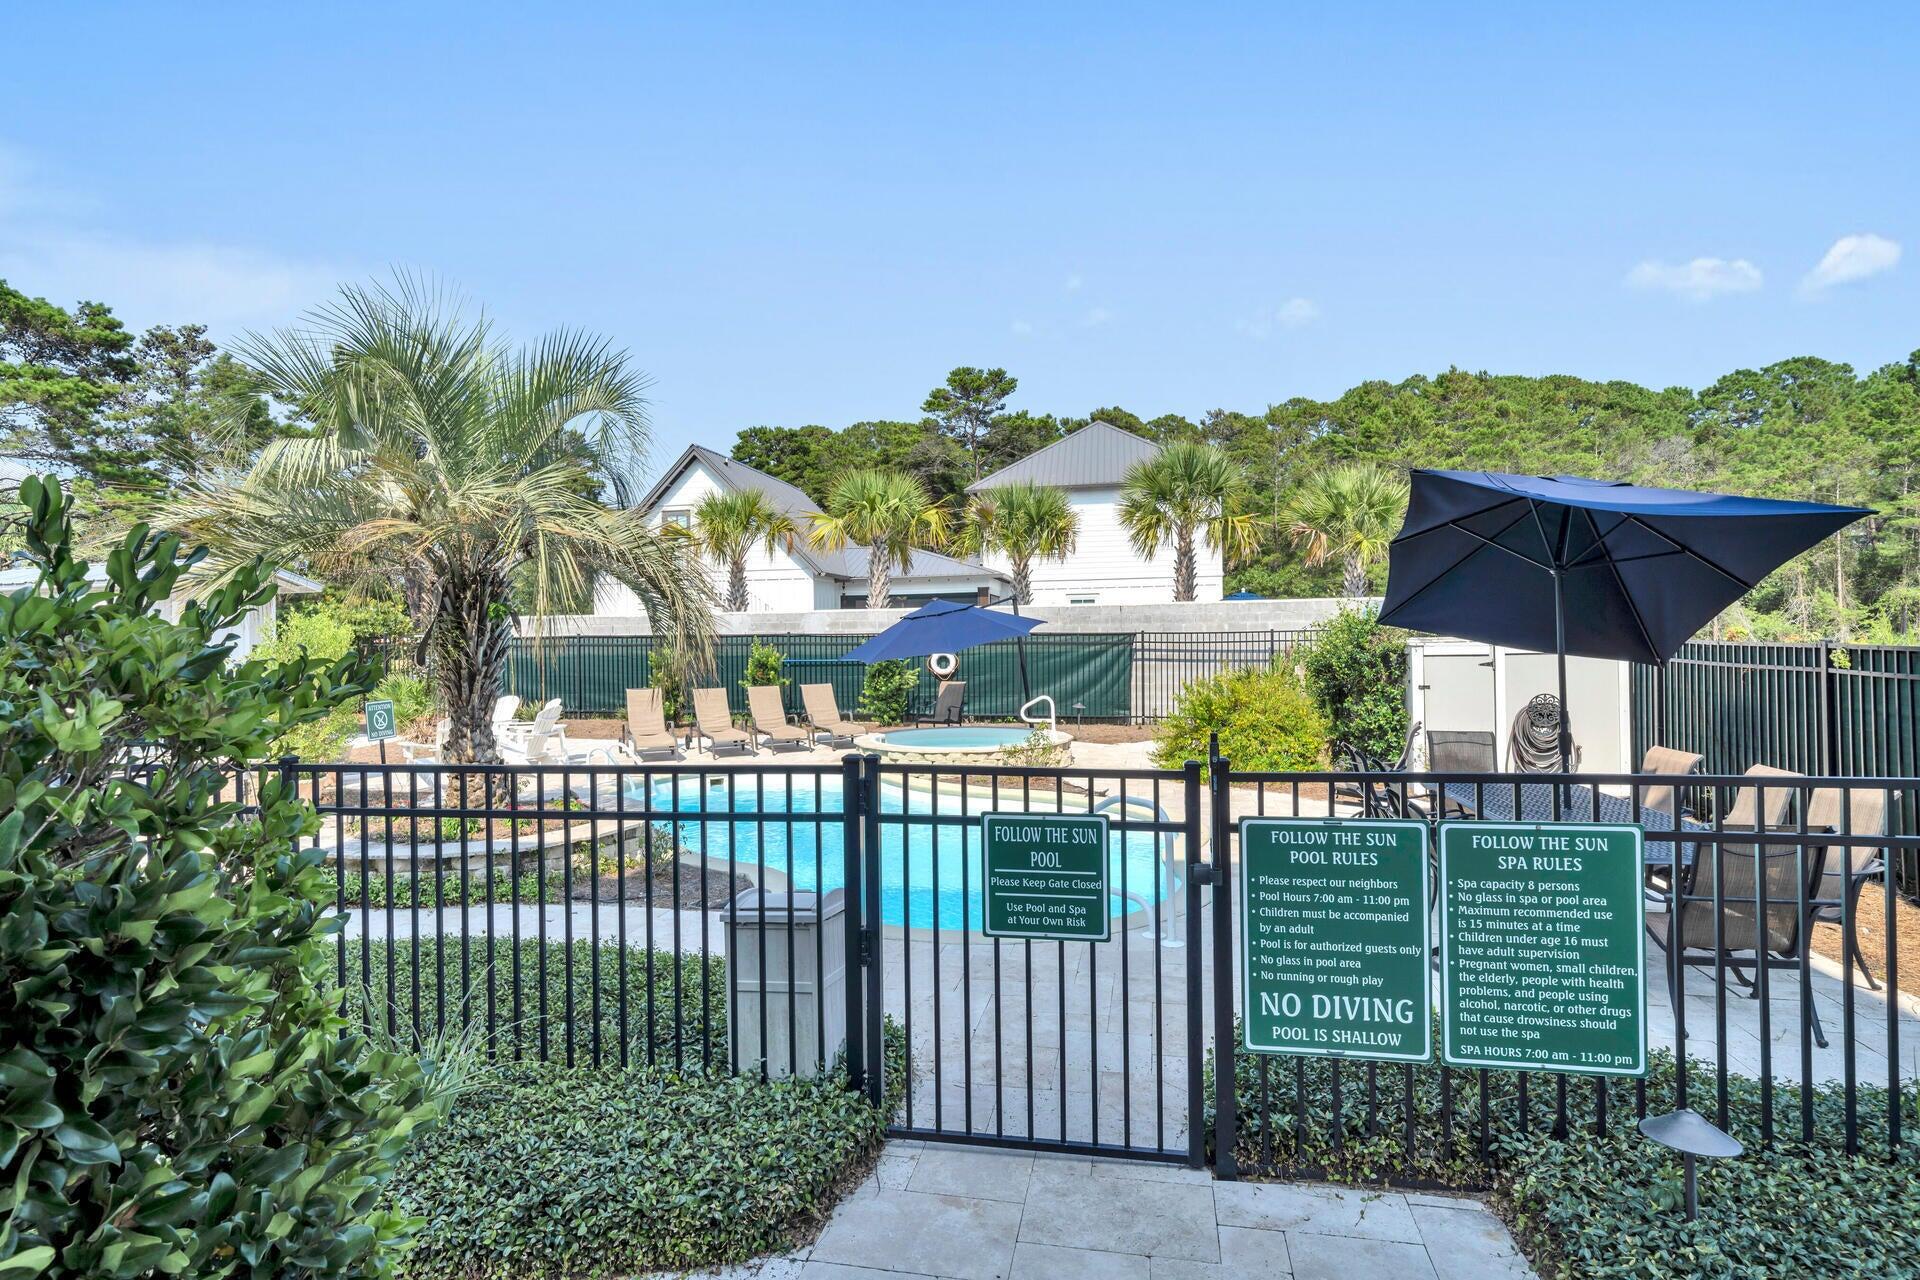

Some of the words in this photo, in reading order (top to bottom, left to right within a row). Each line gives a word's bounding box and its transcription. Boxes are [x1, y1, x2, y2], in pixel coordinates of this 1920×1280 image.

[995, 826, 1041, 843] FOLLOW
[1045, 828, 1068, 843] THE
[1072, 828, 1097, 844] SUN
[1271, 831, 1328, 845] FOLLOW
[1332, 832, 1361, 845] THE
[1366, 833, 1397, 847] SUN
[1472, 835, 1534, 849] FOLLOW
[1539, 837, 1570, 850] THE
[1575, 837, 1609, 851] SUN
[1031, 852, 1061, 868] POOL
[1290, 851, 1328, 864] POOL
[1333, 852, 1378, 865] RULES
[1498, 856, 1527, 870] SPA
[1533, 857, 1582, 871] RULES
[991, 877, 1019, 886] Please
[1023, 879, 1045, 889] Keep
[1049, 879, 1069, 888] Gate
[1072, 880, 1101, 889] Closed
[1259, 876, 1290, 886] Please
[1292, 878, 1327, 888] respect
[1349, 879, 1398, 889] neighbors
[1457, 879, 1477, 890] Spa
[1480, 880, 1525, 891] capacity
[1528, 881, 1535, 890] 8
[1538, 882, 1580, 892] persons
[1259, 892, 1280, 901] Pool
[1283, 893, 1311, 902] Hours
[1314, 894, 1335, 903] 7:00
[1337, 896, 1353, 904] am
[1363, 896, 1391, 905] 11:00
[1394, 898, 1410, 907] pm
[1458, 892, 1472, 901] No
[1476, 893, 1503, 904] glass
[1506, 893, 1516, 903] in
[1519, 895, 1538, 904] spa
[1541, 896, 1553, 904] or
[1556, 895, 1578, 906] pool
[1582, 897, 1607, 906] area
[1007, 903, 1023, 911] Use
[1026, 904, 1045, 912] Pool
[1048, 905, 1066, 913] and
[1069, 905, 1086, 915] Spa
[1259, 908, 1299, 918] Children
[1302, 910, 1326, 919] must
[1329, 910, 1341, 920] be
[1343, 911, 1409, 923] accompanied
[1458, 905, 1510, 916] Maximum
[1514, 908, 1590, 919] recommended
[1593, 911, 1613, 920] use
[1008, 916, 1016, 924] at
[1019, 916, 1040, 924] Your
[1043, 917, 1063, 926] Own
[1067, 918, 1086, 927] Risk
[1259, 923, 1271, 934] by
[1274, 925, 1286, 933] an
[1289, 924, 1314, 934] adult
[1458, 919, 1466, 928] is
[1470, 919, 1483, 929] 15
[1486, 920, 1529, 930] minutes
[1532, 922, 1543, 931] at
[1546, 923, 1553, 931] a
[1556, 922, 1580, 932] time
[1458, 932, 1502, 943] Children
[1506, 934, 1537, 944] under
[1541, 936, 1561, 947] age
[1564, 936, 1578, 945] 16
[1581, 938, 1608, 947] must
[1260, 939, 1280, 949] Pool
[1284, 940, 1291, 949] is
[1294, 941, 1307, 950] for
[1310, 942, 1362, 952] authorized
[1365, 945, 1396, 954] guests
[1399, 945, 1421, 957] only
[1458, 946, 1485, 956] have
[1487, 947, 1515, 957] adult
[1518, 948, 1580, 960] supervision
[1260, 955, 1273, 964] No
[1276, 956, 1300, 967] glass
[1303, 957, 1313, 966] in
[1316, 958, 1336, 968] pool
[1339, 960, 1361, 968] area
[1459, 959, 1507, 971] Pregnant
[1510, 962, 1553, 973] women,
[1556, 964, 1586, 973] small
[1261, 971, 1274, 980] No
[1277, 973, 1314, 983] running
[1330, 974, 1359, 986] rough
[1362, 976, 1383, 986] play
[1459, 973, 1476, 982] the
[1479, 974, 1518, 985] elderly,
[1522, 976, 1559, 988] people
[1561, 977, 1586, 987] with
[1589, 979, 1624, 989] health
[1459, 986, 1512, 998] problems,
[1514, 988, 1535, 998] and
[1538, 990, 1576, 1001] people
[1578, 992, 1609, 1004] using
[1260, 991, 1301, 1018] NO
[1312, 994, 1414, 1024] DIVING
[1459, 999, 1500, 1010] alcohol,
[1504, 1001, 1550, 1013] narcotic,
[1553, 1005, 1565, 1013] or
[1568, 1005, 1597, 1015] other
[1600, 1006, 1632, 1018] drugs
[1460, 1012, 1481, 1023] that
[1484, 1015, 1514, 1024] cause
[1517, 1015, 1577, 1027] drowsiness
[1580, 1019, 1617, 1030] should
[1272, 1027, 1310, 1041] POOL
[1314, 1029, 1327, 1041] IS
[1332, 1030, 1402, 1046] SHALLOW
[1460, 1027, 1477, 1036] not
[1480, 1028, 1499, 1036] use
[1502, 1028, 1519, 1038] the
[1522, 1030, 1540, 1039] spa
[1461, 1045, 1481, 1055] SPA
[1485, 1046, 1522, 1057] HOURS
[1525, 1048, 1549, 1059] 7:00
[1552, 1051, 1569, 1060] am
[1581, 1053, 1611, 1063] 11:00
[1614, 1055, 1633, 1065] pm
